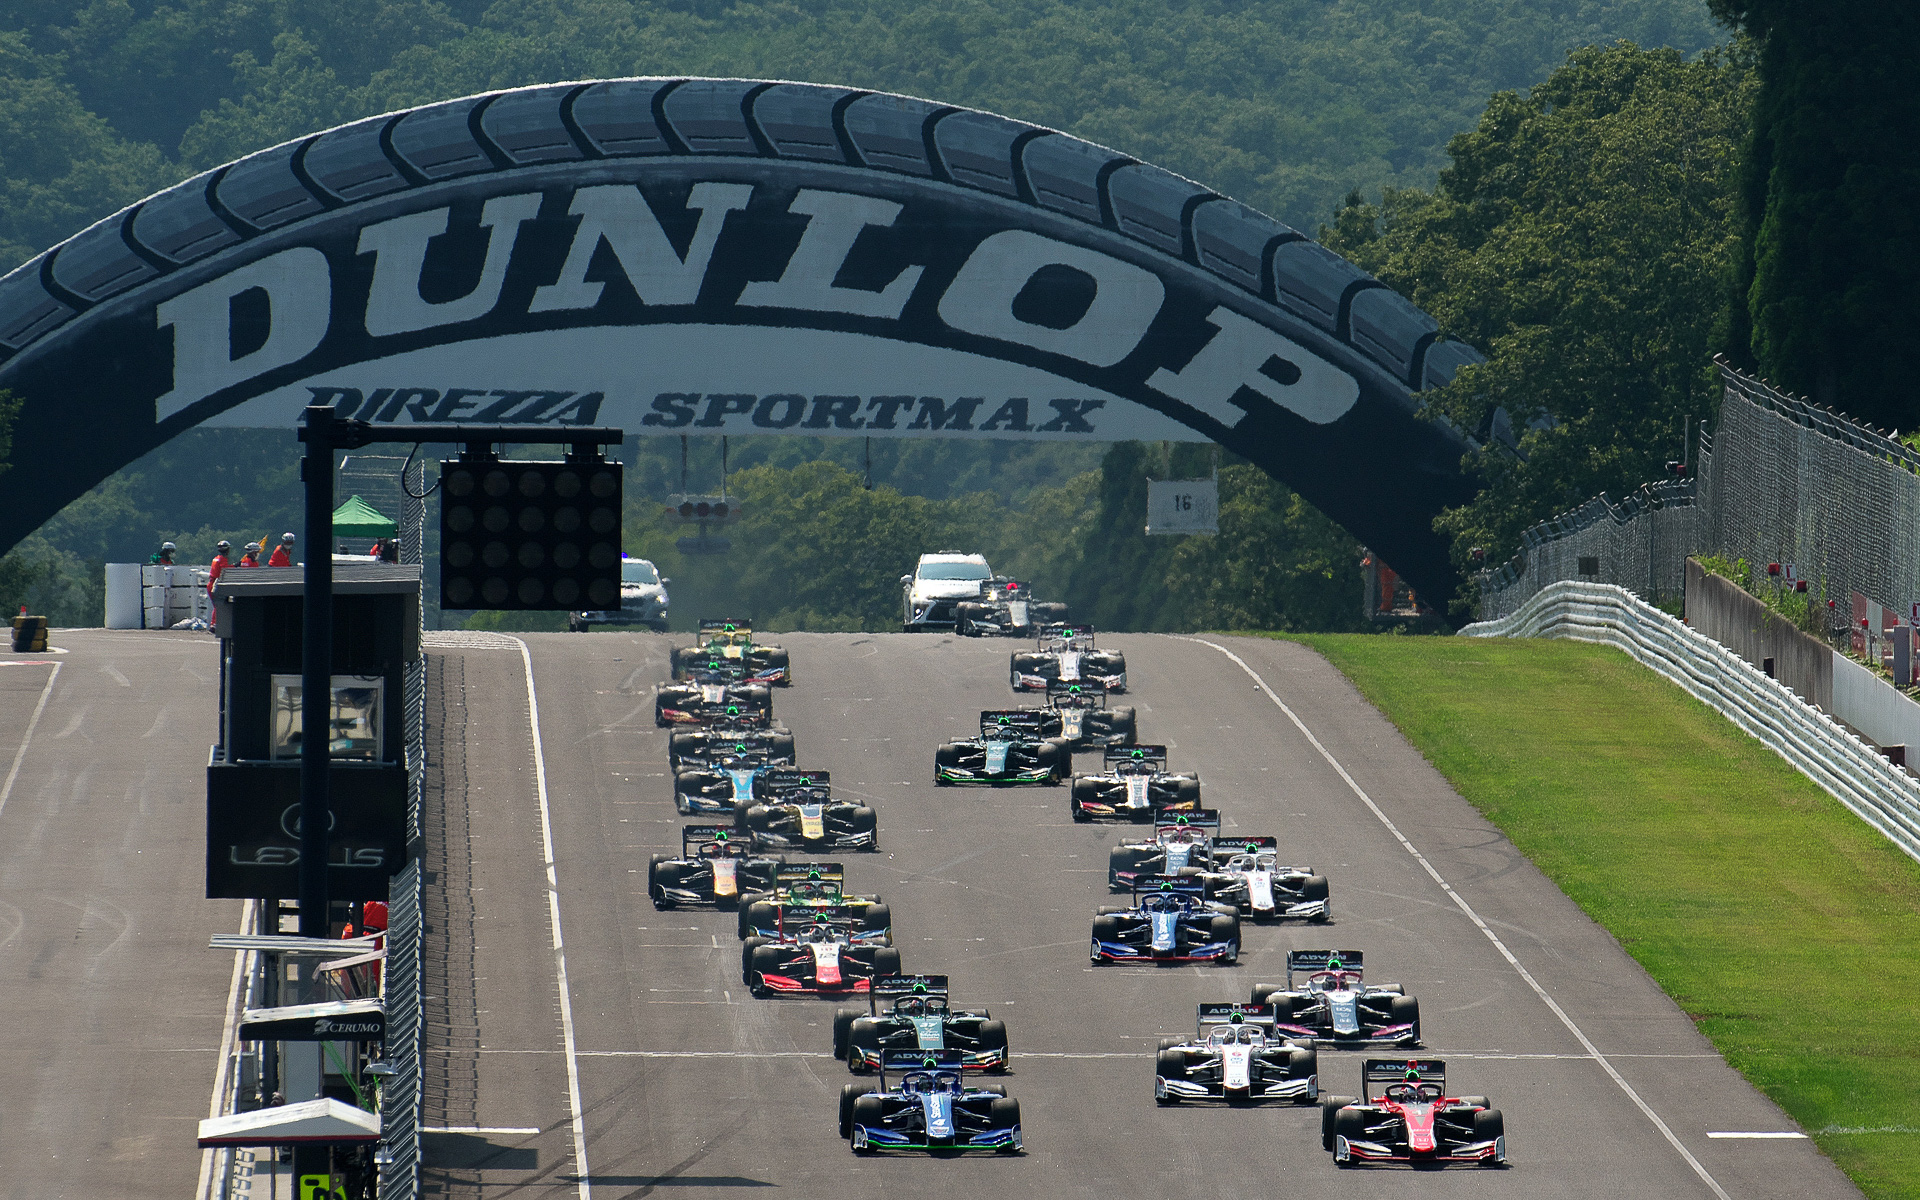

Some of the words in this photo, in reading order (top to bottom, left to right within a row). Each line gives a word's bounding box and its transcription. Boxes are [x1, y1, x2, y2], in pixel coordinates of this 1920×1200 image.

[155, 181, 1360, 427] DUNLOP
[297, 387, 604, 425] DIREZZA
[641, 392, 1105, 433] SPORTMAX
[1175, 493, 1192, 511] 16
[329, 1023, 380, 1033] CERUMO
